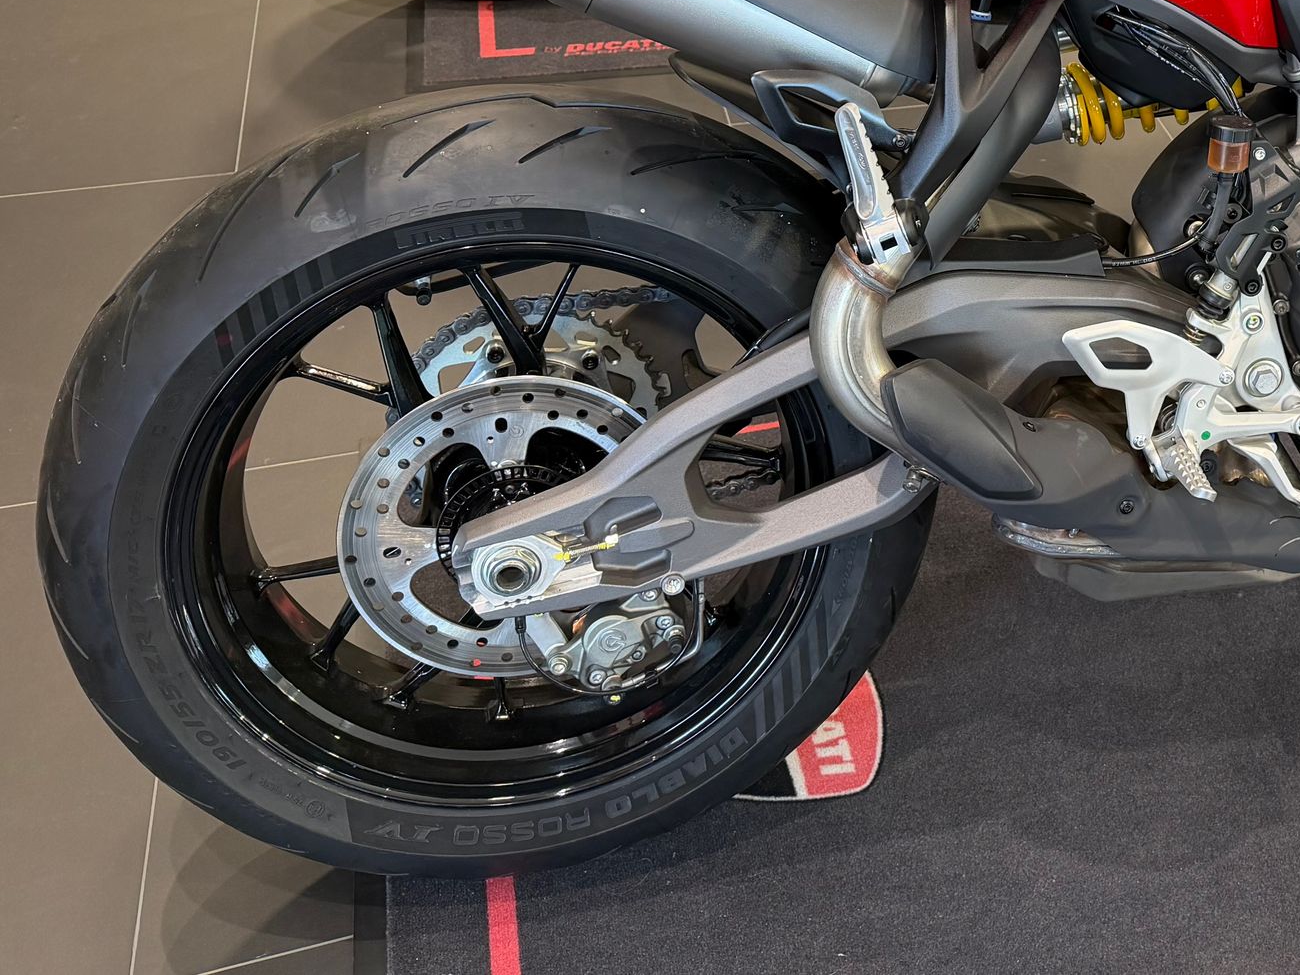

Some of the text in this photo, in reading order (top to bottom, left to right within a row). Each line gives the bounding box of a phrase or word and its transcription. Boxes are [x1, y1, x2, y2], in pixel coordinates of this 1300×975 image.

[605, 726, 749, 819] DIABLO
[811, 721, 856, 776] ATI
[453, 807, 591, 847] ROSSO
